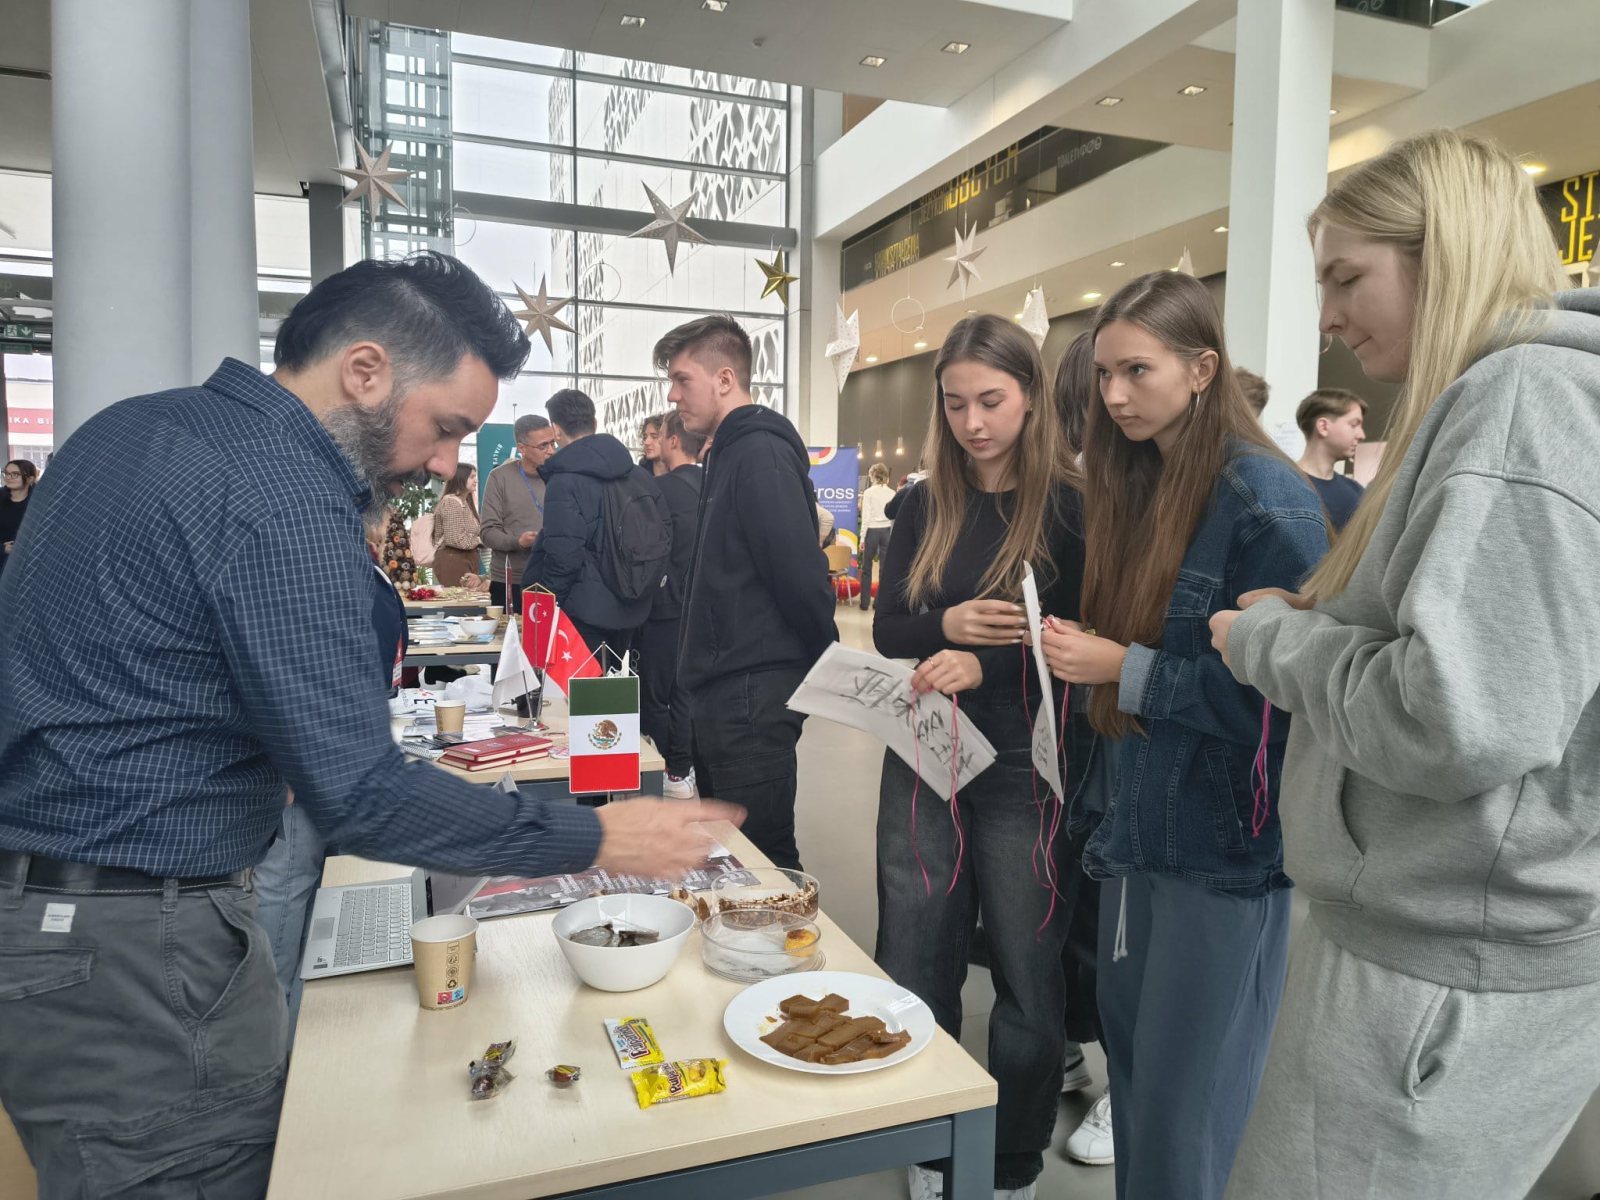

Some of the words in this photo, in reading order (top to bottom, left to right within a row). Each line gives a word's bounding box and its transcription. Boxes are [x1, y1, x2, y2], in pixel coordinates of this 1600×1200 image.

[1561, 171, 1600, 223] ST
[37, 417, 54, 425] BI
[813, 487, 854, 499] ross
